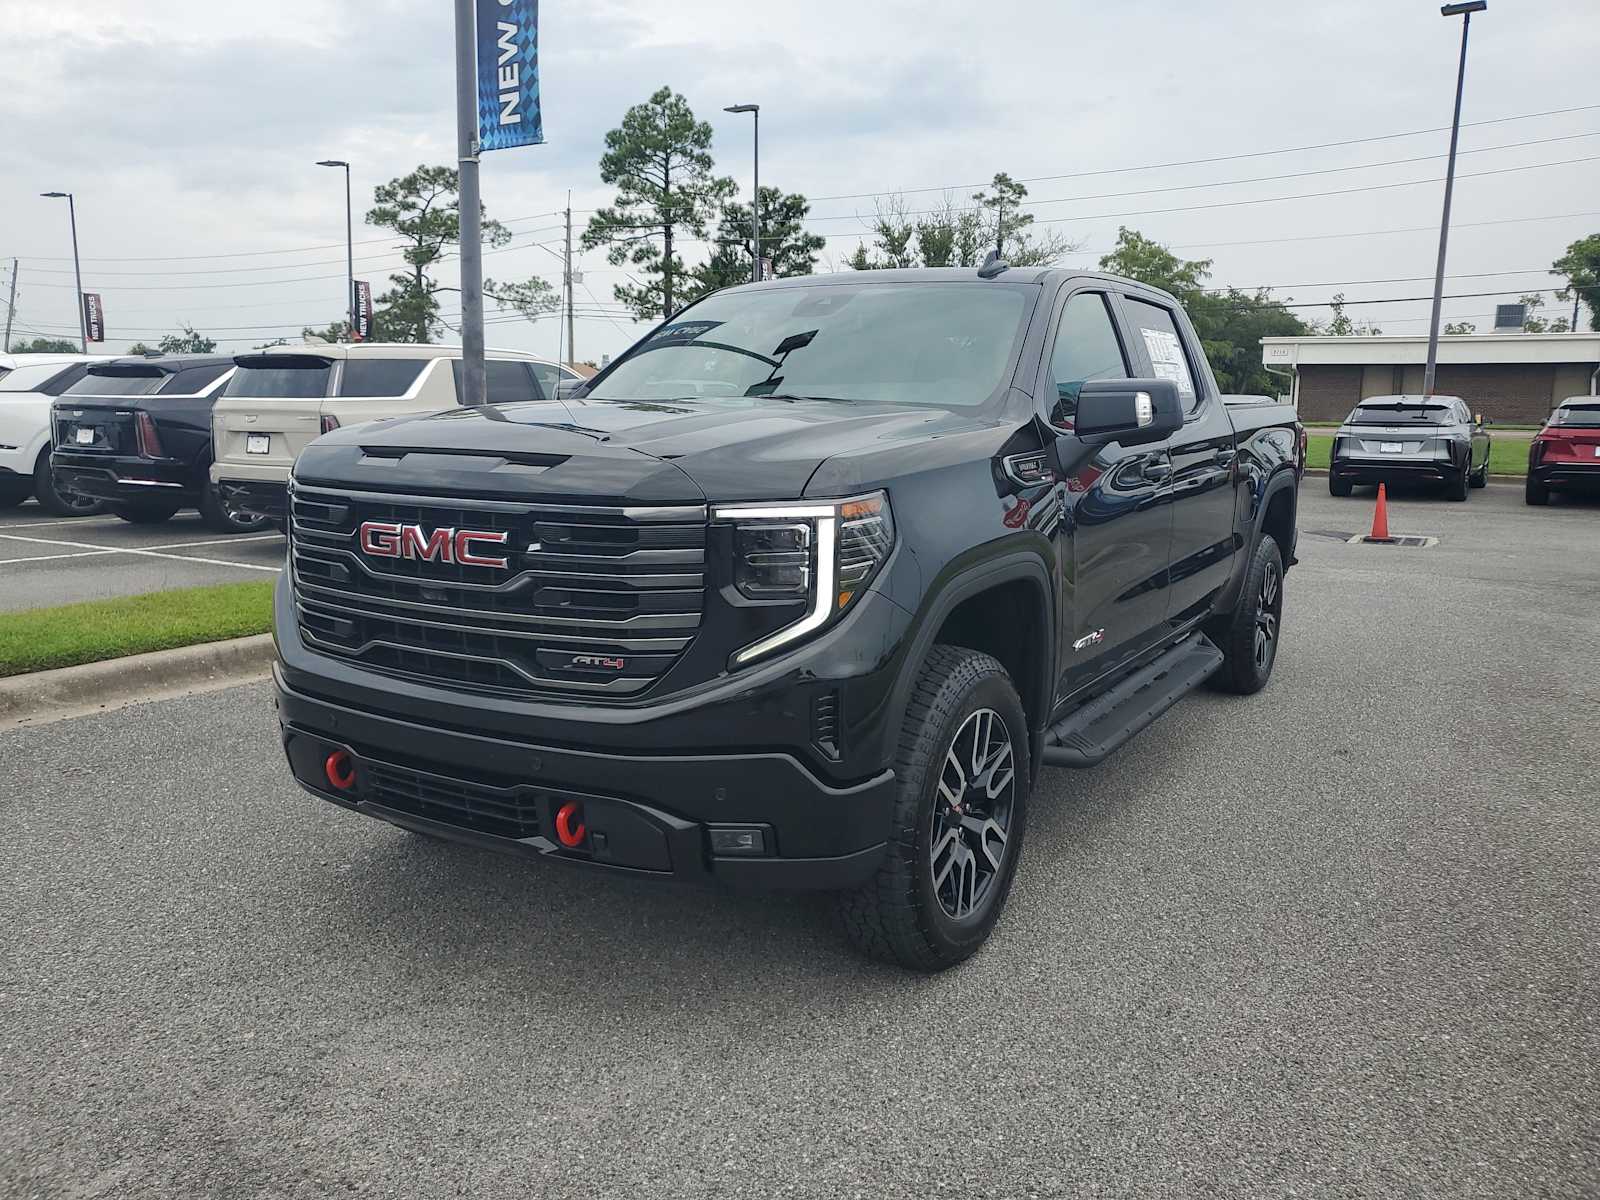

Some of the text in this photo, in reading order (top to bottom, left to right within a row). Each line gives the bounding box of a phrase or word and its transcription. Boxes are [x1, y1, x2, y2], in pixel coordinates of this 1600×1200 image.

[497, 22, 520, 125] NEW
[88, 296, 99, 340] NEW TRUCKS
[358, 284, 367, 336] NEW TRUCKS
[360, 520, 509, 570] GMC
[572, 655, 624, 670] AT4
